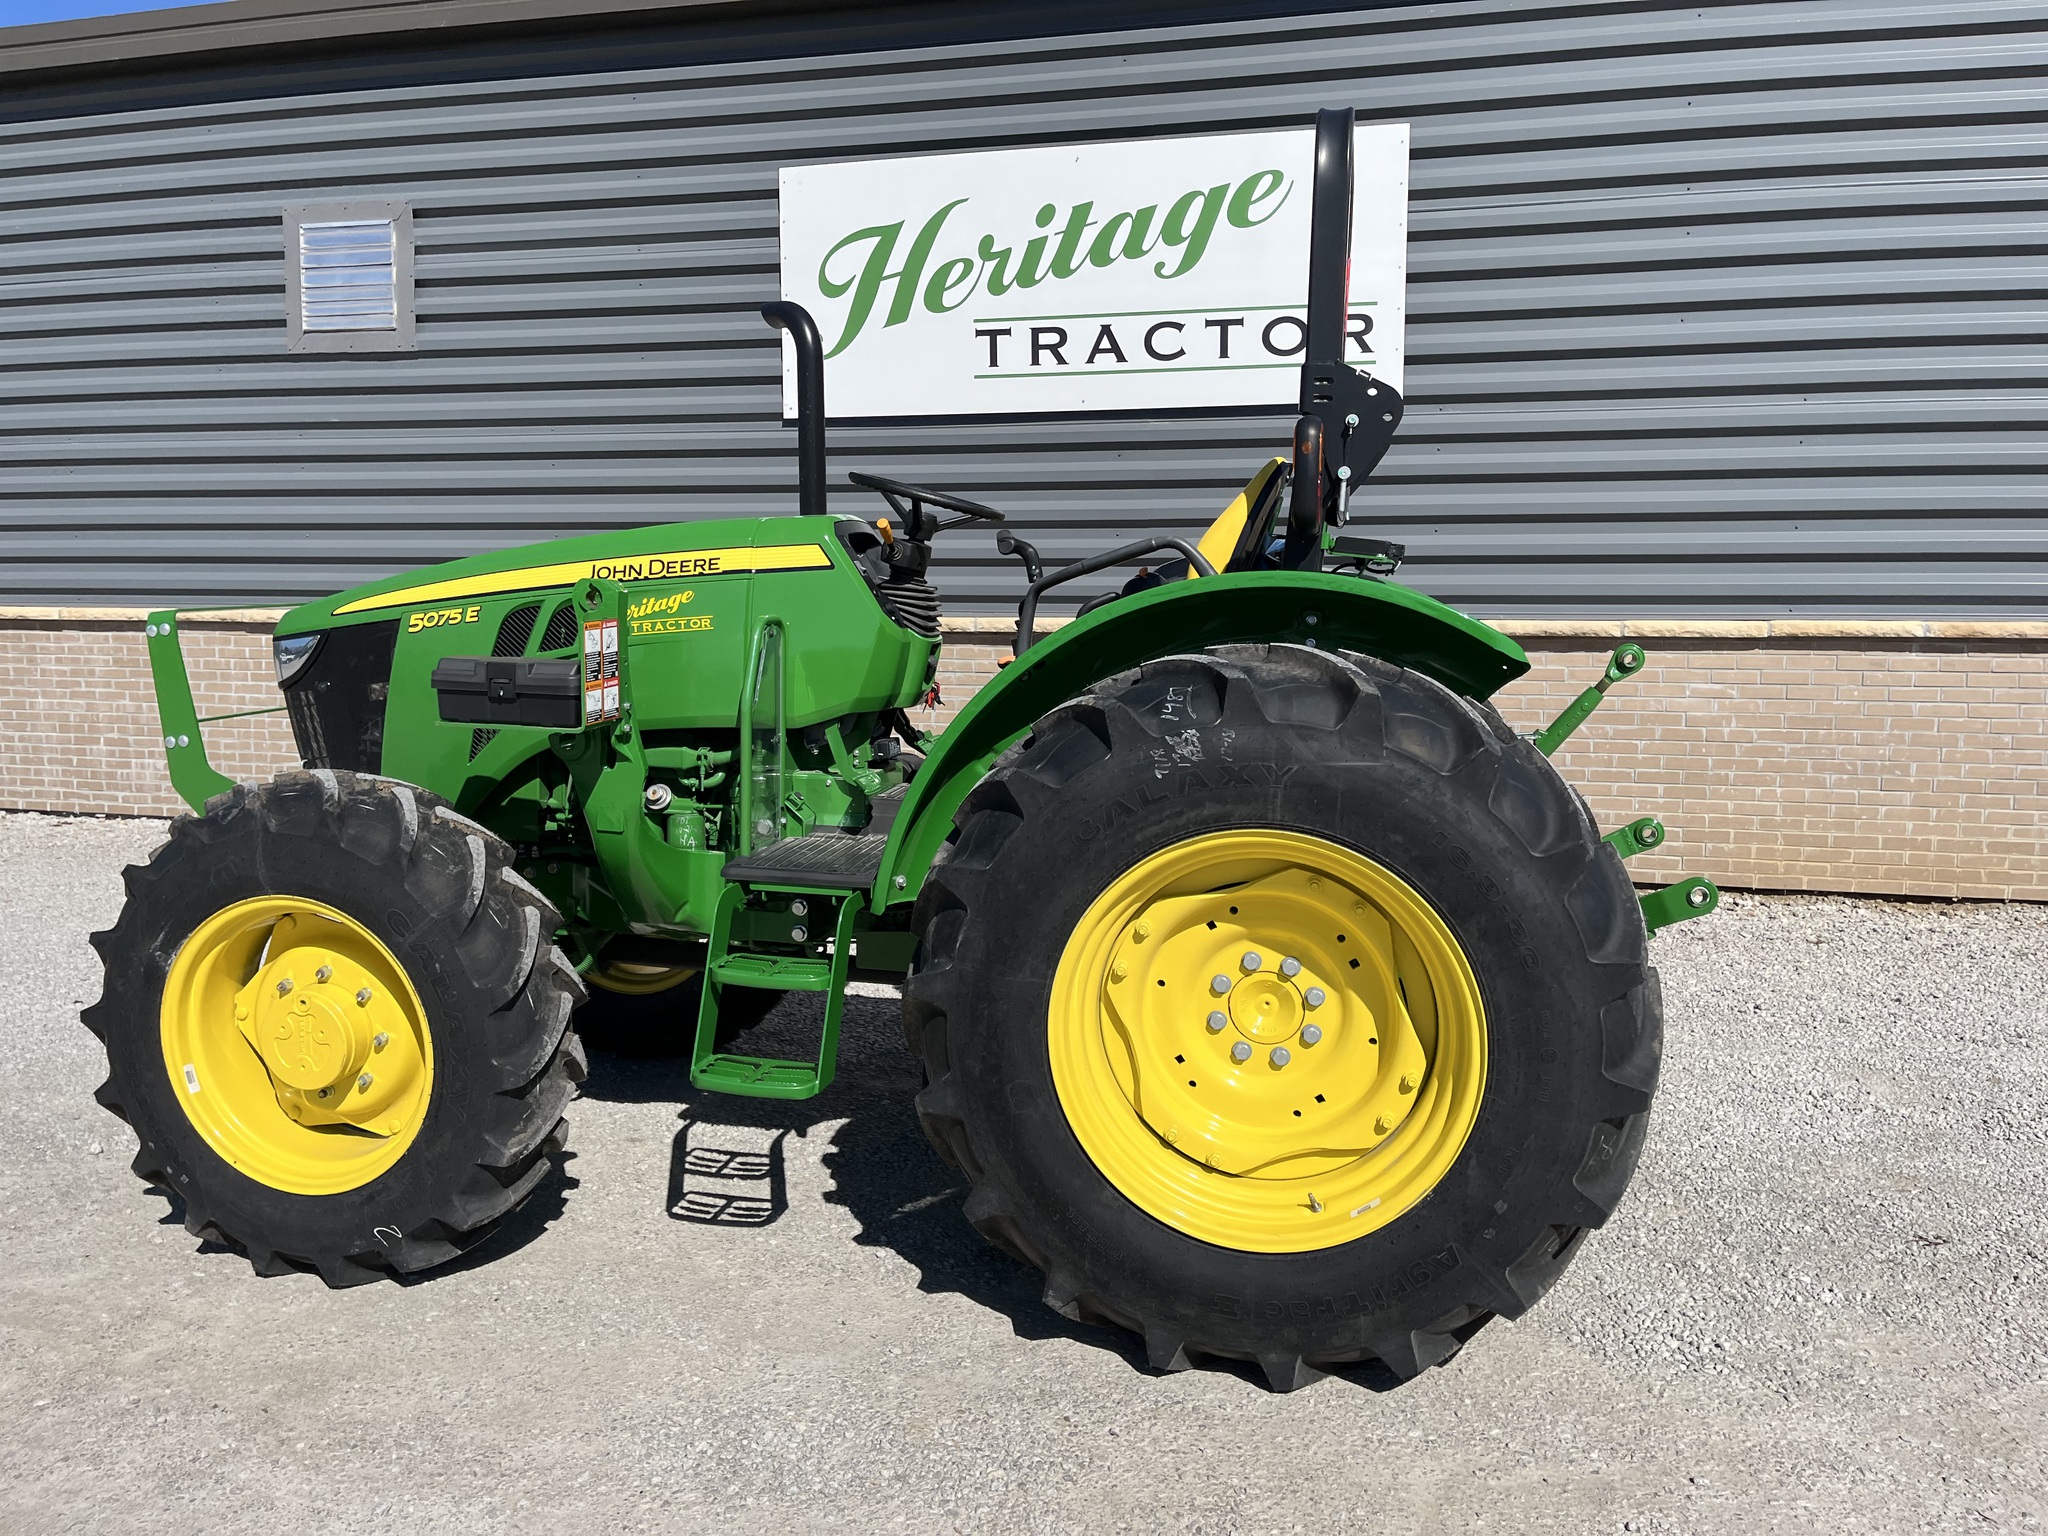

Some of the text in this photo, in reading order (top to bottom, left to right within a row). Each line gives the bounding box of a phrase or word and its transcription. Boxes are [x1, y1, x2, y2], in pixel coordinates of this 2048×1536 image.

[817, 168, 1294, 360] Heritage
[591, 557, 721, 580] JOHN DEERE
[408, 605, 482, 633] 5075 E
[631, 618, 711, 633] TRACTOR
[1071, 760, 1299, 848] GALAXY
